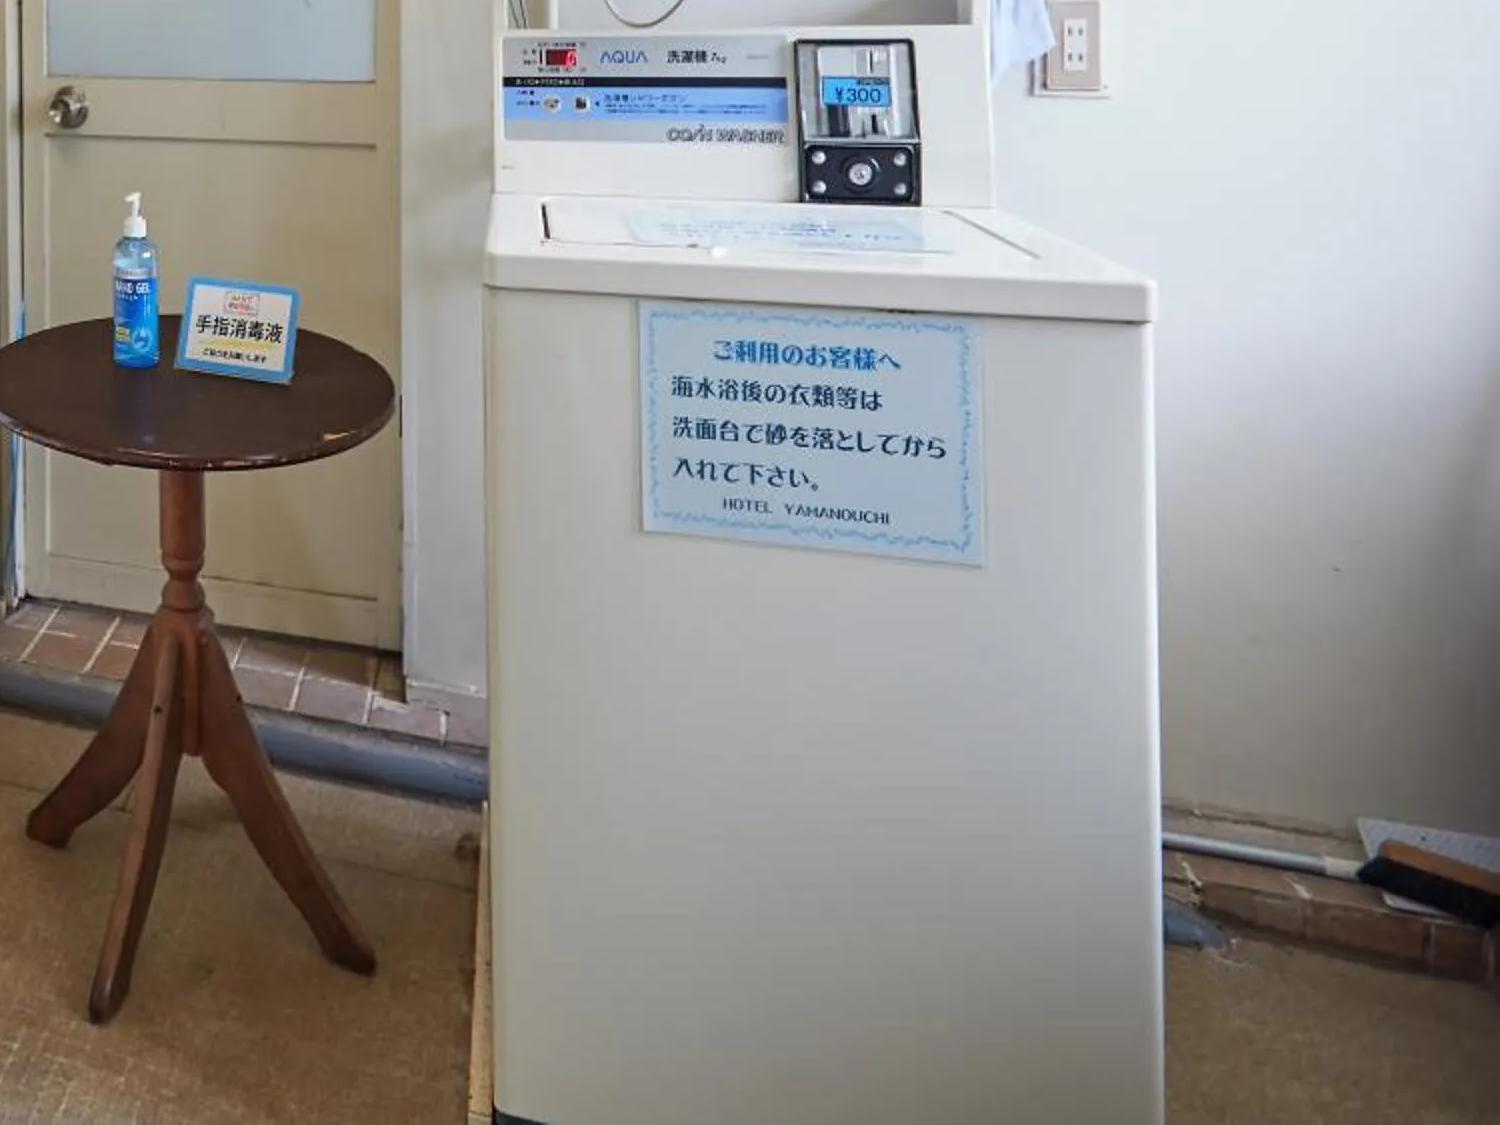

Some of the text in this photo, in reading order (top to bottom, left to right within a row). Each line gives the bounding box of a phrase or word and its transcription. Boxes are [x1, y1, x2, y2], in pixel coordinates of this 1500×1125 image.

[600, 50, 649, 64] AQUA
[667, 49, 708, 64] 洗濯機
[835, 86, 882, 104] ¥300
[195, 314, 284, 344] 手指消毒液
[712, 339, 902, 372] ご利用のお客様へ
[670, 374, 884, 412] 海水浴後の衣類等は
[672, 415, 948, 460] 洗面台で砂を落としてから
[673, 456, 819, 492] 入れて下さい。
[722, 497, 891, 525] HOTEL YAMANOUCHI
